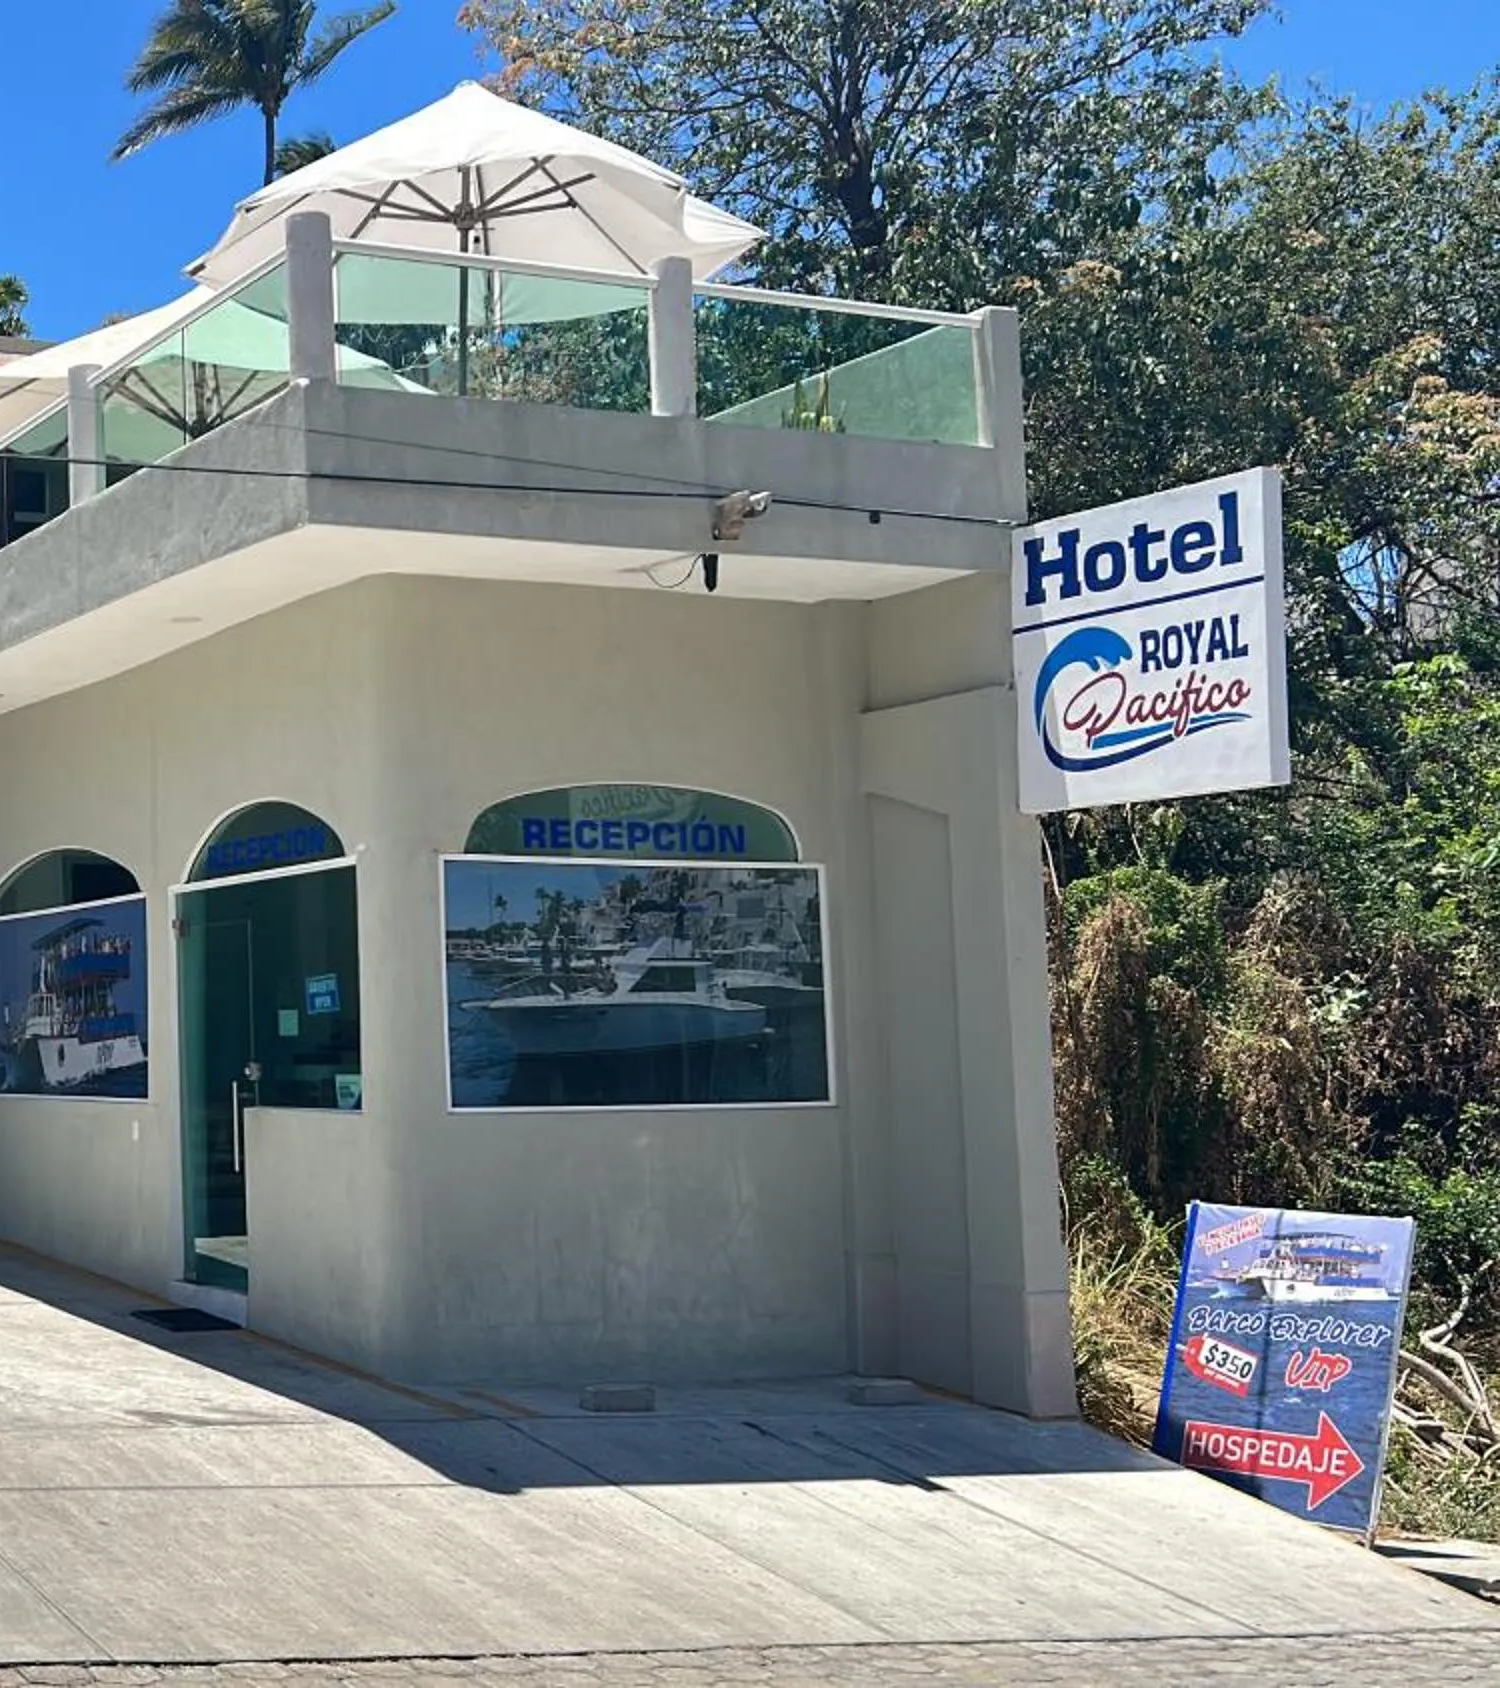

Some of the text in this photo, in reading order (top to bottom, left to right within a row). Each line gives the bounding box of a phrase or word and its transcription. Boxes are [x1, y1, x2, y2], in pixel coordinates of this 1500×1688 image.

[1024, 491, 1243, 606] Hotel
[1140, 613, 1249, 674] ROYAL
[521, 815, 745, 854] RECEPCIÓN
[1189, 1305, 1391, 1347] Barco Explorer
[1204, 1343, 1252, 1378] $350
[1189, 1430, 1350, 1476] HOSPEDAJE
